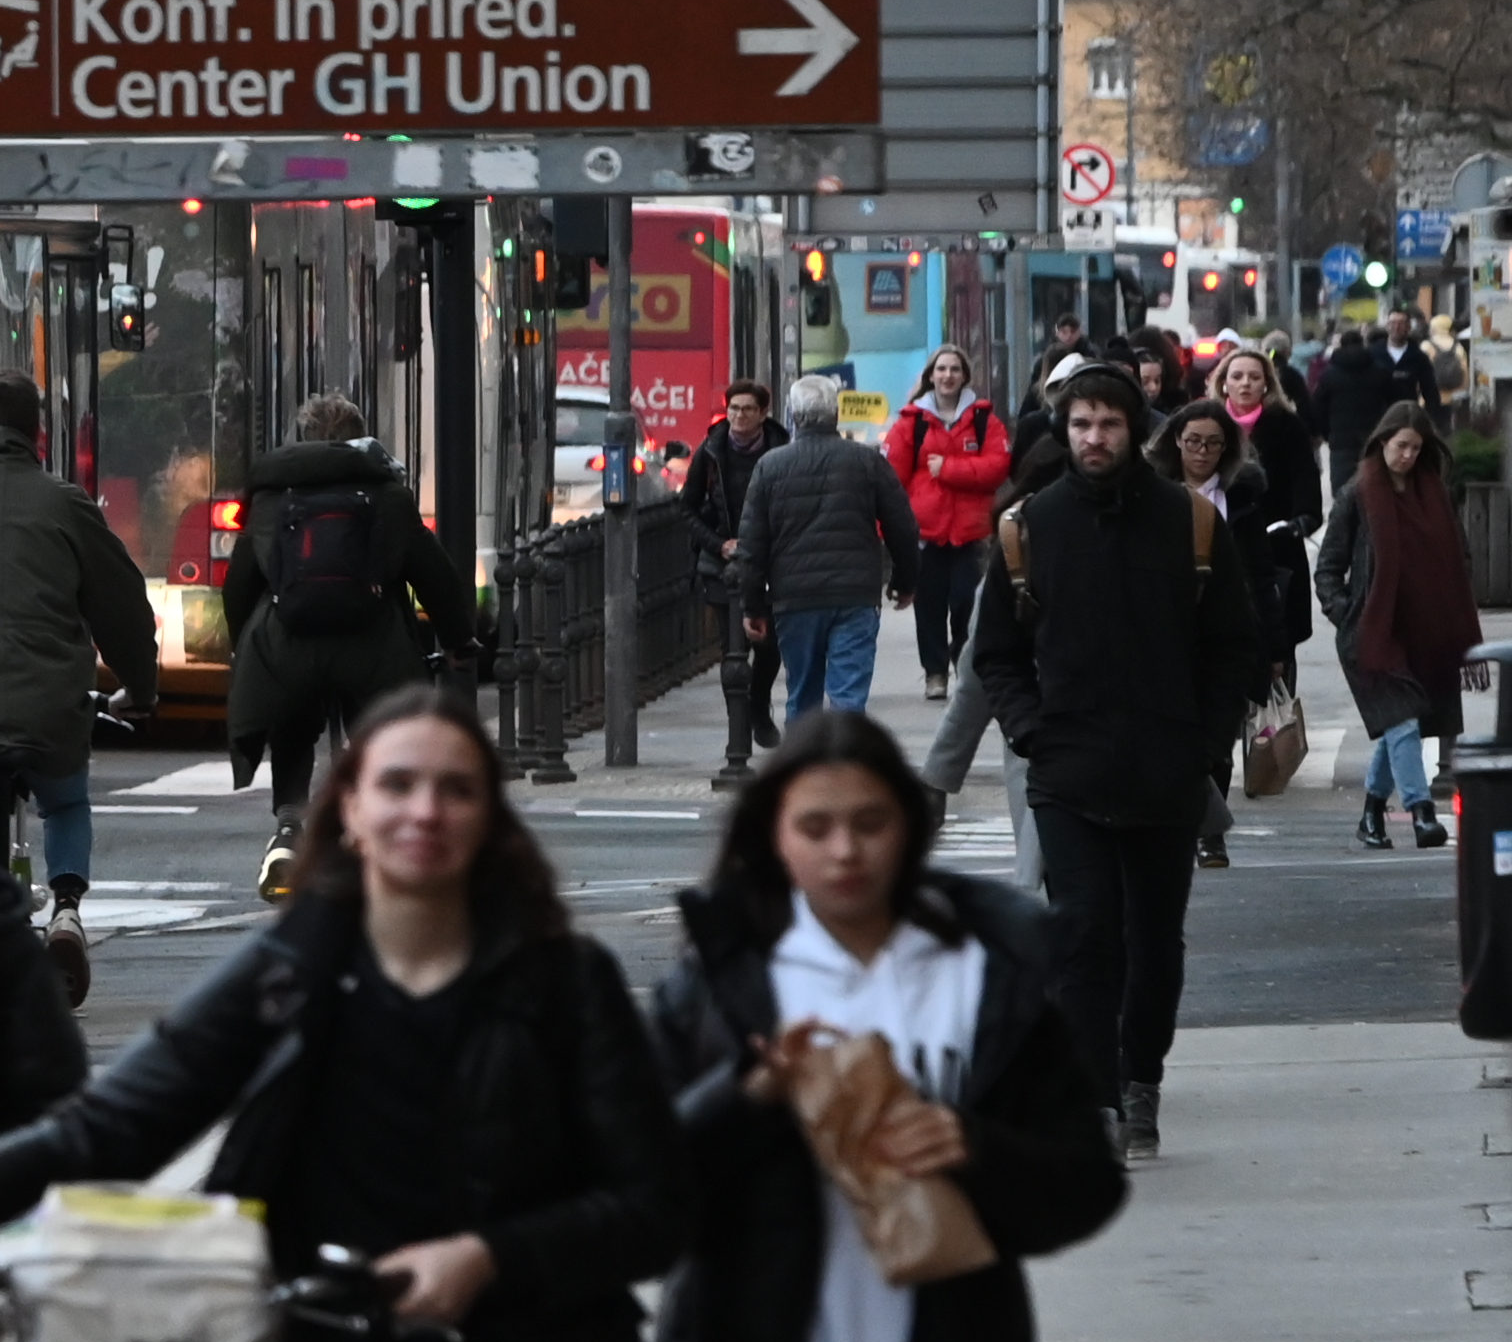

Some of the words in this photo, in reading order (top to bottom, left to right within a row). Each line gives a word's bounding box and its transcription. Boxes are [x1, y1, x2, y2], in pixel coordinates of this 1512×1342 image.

[72, 55, 295, 119] Center
[314, 51, 421, 116] GH
[446, 50, 651, 114] Union
[630, 378, 695, 410] AČE!
